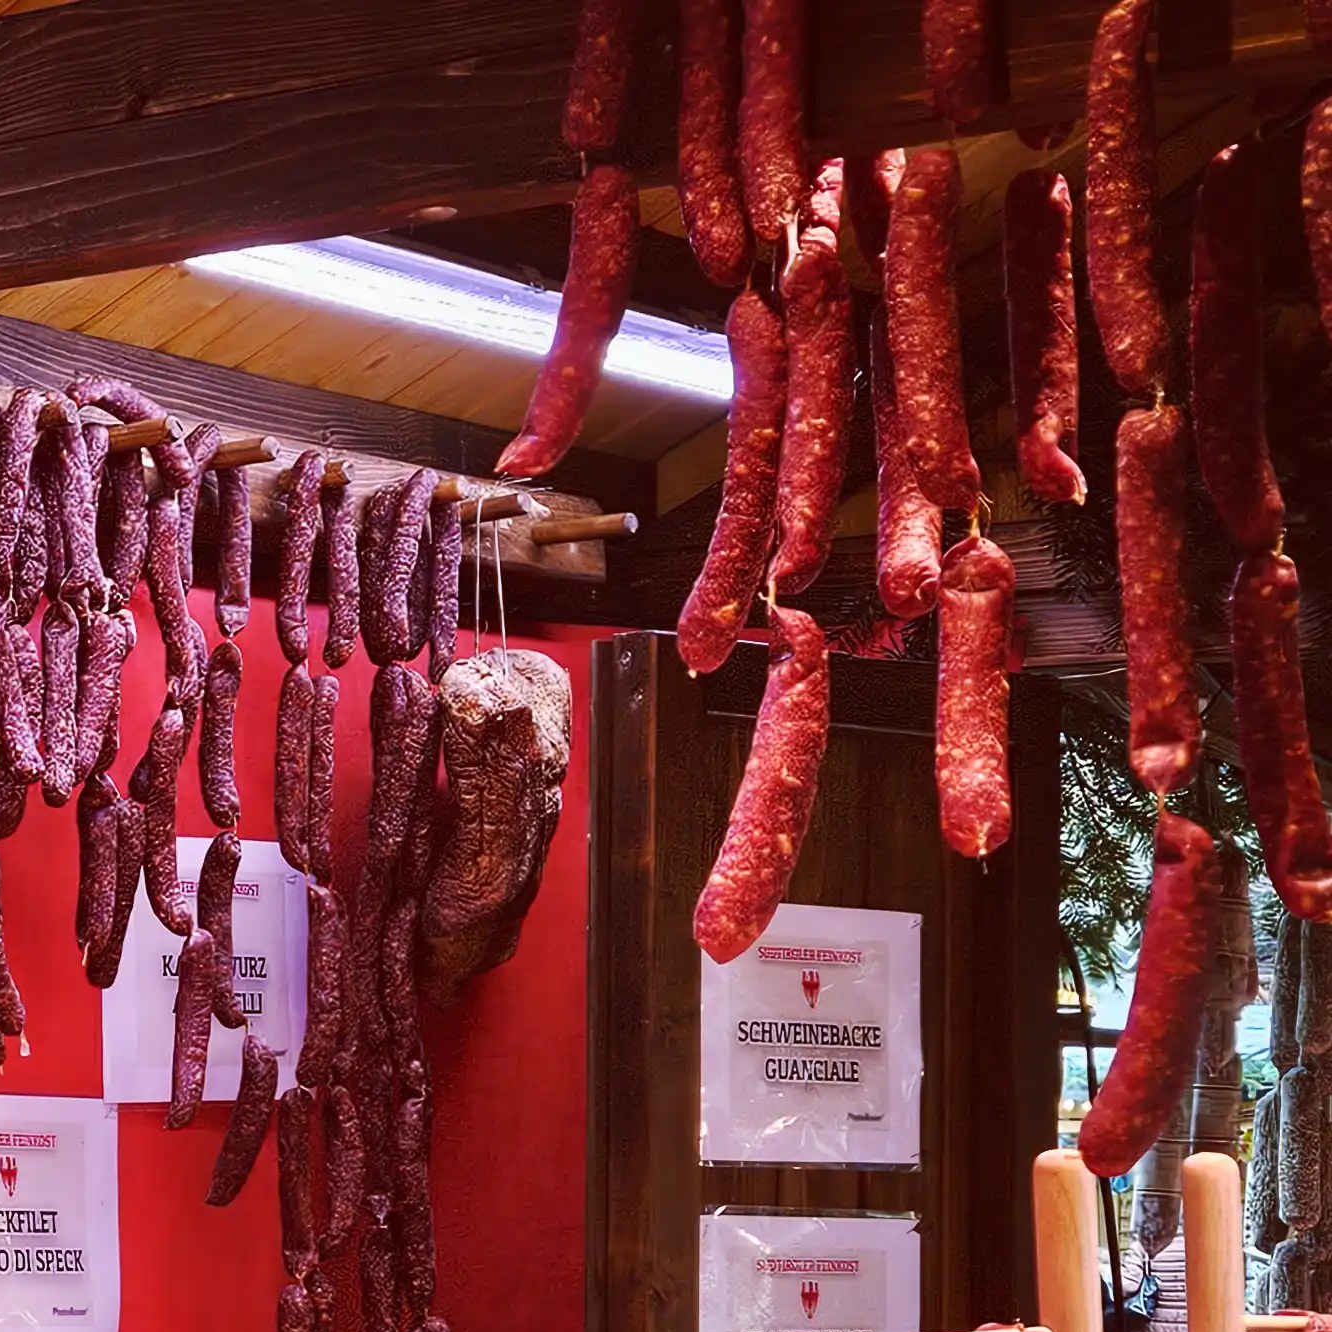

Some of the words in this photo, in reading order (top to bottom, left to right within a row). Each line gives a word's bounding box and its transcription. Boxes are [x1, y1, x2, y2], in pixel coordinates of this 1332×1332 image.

[737, 1020, 882, 1048] SCHWEINEBACKE
[765, 1057, 860, 1082] GUANCIALE
[15, 1250, 32, 1272] DI
[35, 1249, 85, 1272] SPECK
